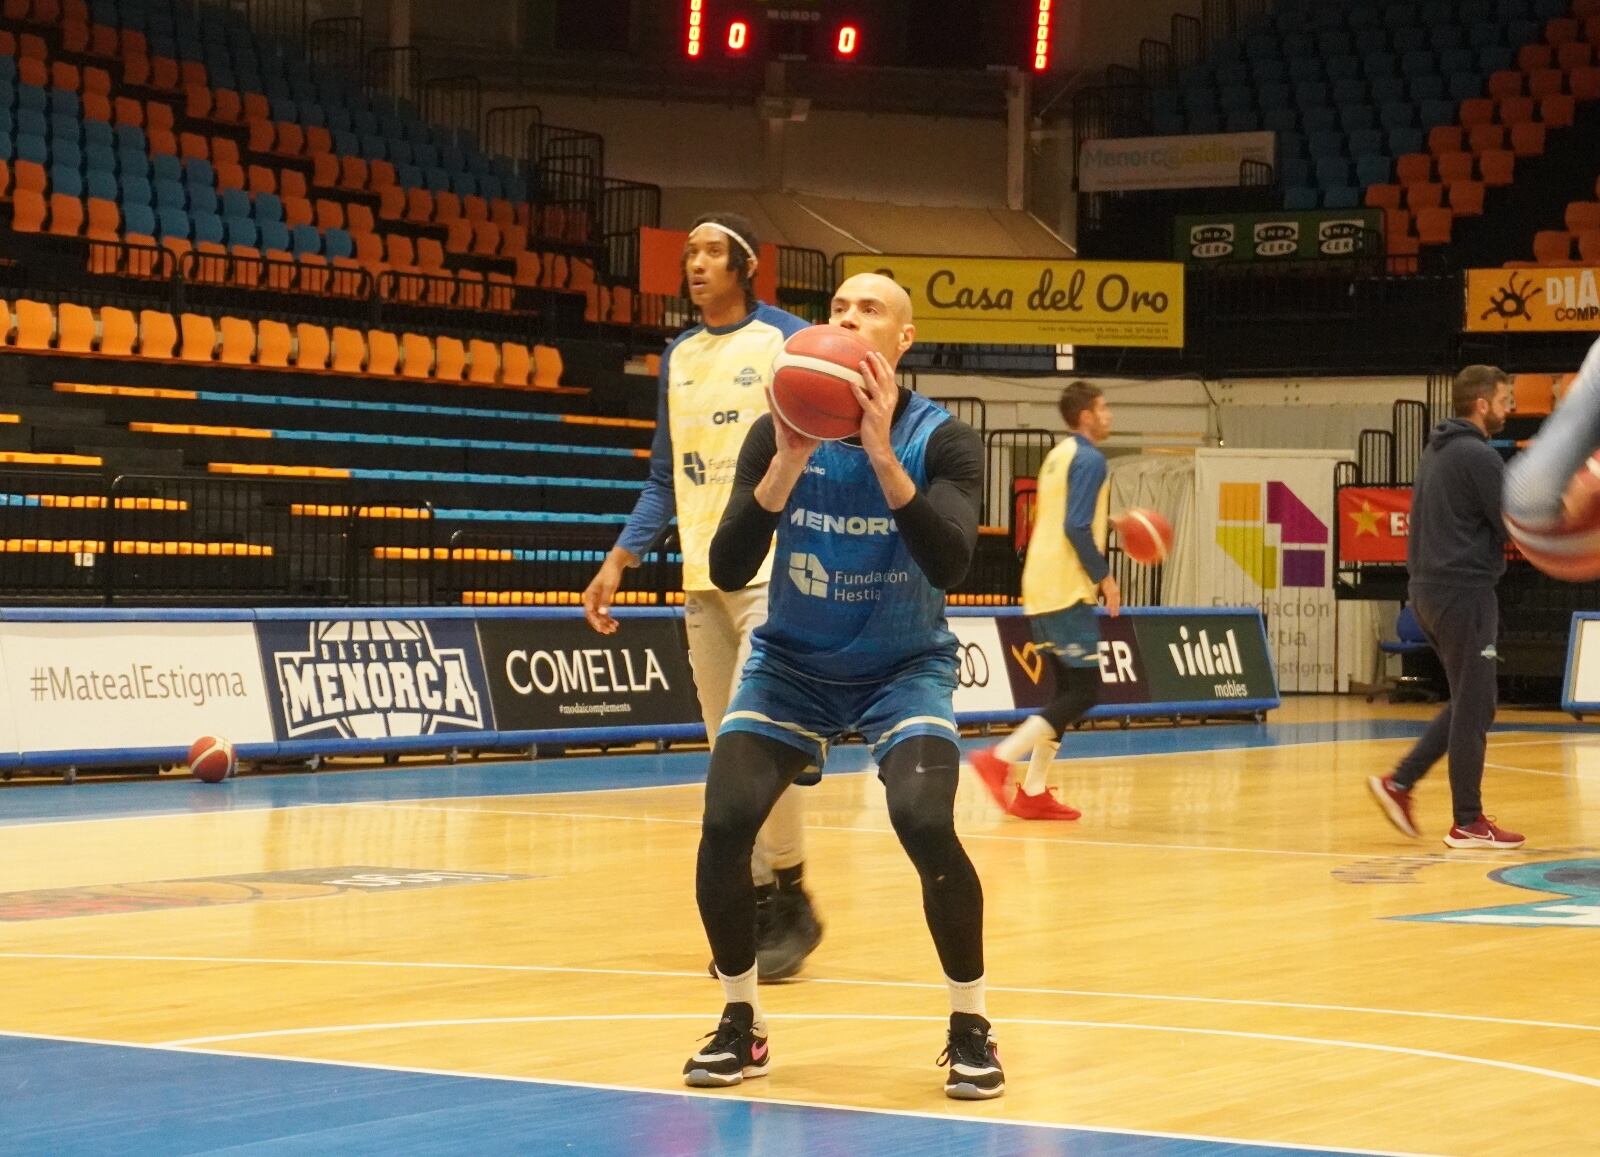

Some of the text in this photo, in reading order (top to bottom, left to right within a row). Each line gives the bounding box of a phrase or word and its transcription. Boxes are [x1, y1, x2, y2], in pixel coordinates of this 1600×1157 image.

[728, 22, 746, 49] 0
[838, 27, 856, 53] 0
[926, 270, 1013, 310] Casa
[1028, 268, 1085, 311] del
[1097, 274, 1168, 313] Oro
[505, 648, 670, 694] COMELLA
[1168, 625, 1244, 677] vidal
[30, 663, 248, 706] #MatealEstigma
[283, 660, 476, 723] MENORCA
[1214, 680, 1248, 698] mobles
